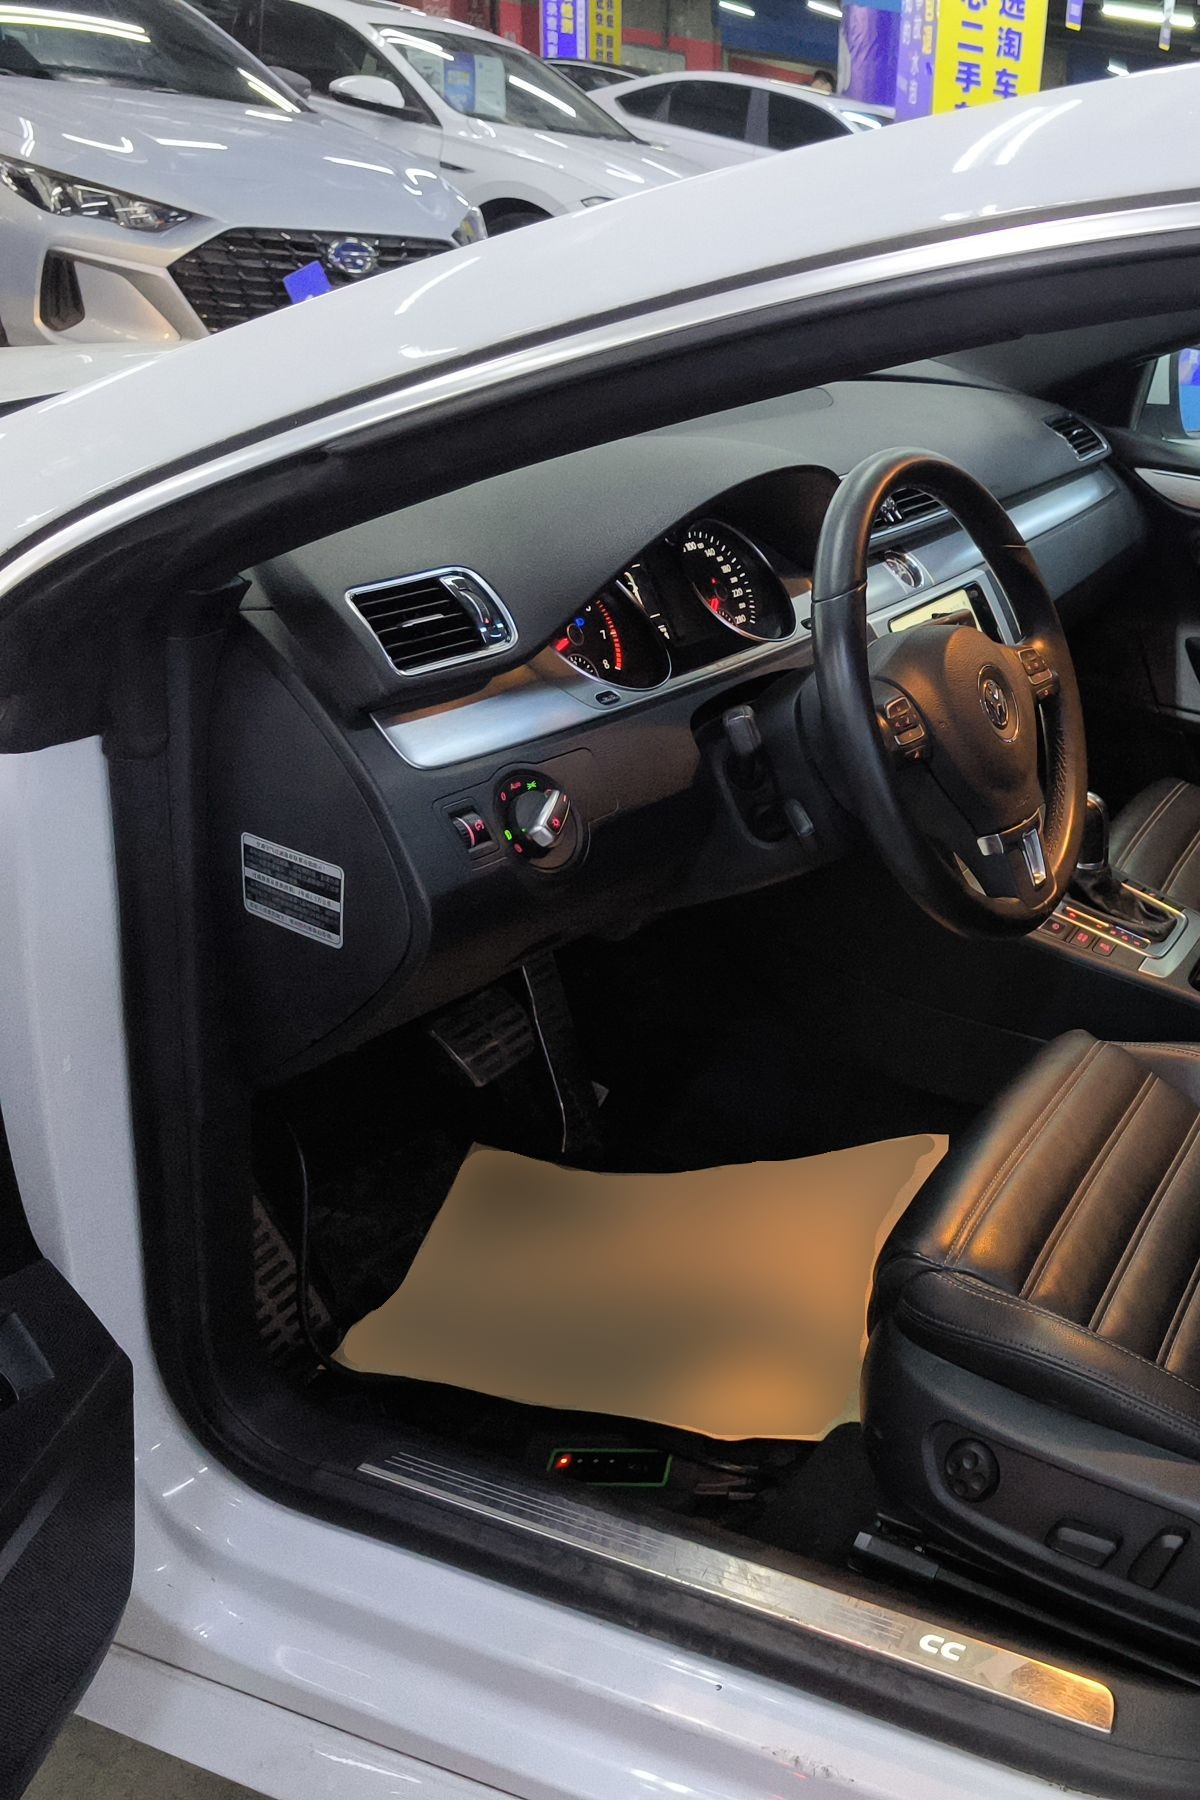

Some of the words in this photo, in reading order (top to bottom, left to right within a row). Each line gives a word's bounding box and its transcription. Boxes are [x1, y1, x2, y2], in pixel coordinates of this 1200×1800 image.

[599, 629, 607, 640] 7
[602, 658, 610, 670] 8
[919, 1634, 967, 1662] CC
